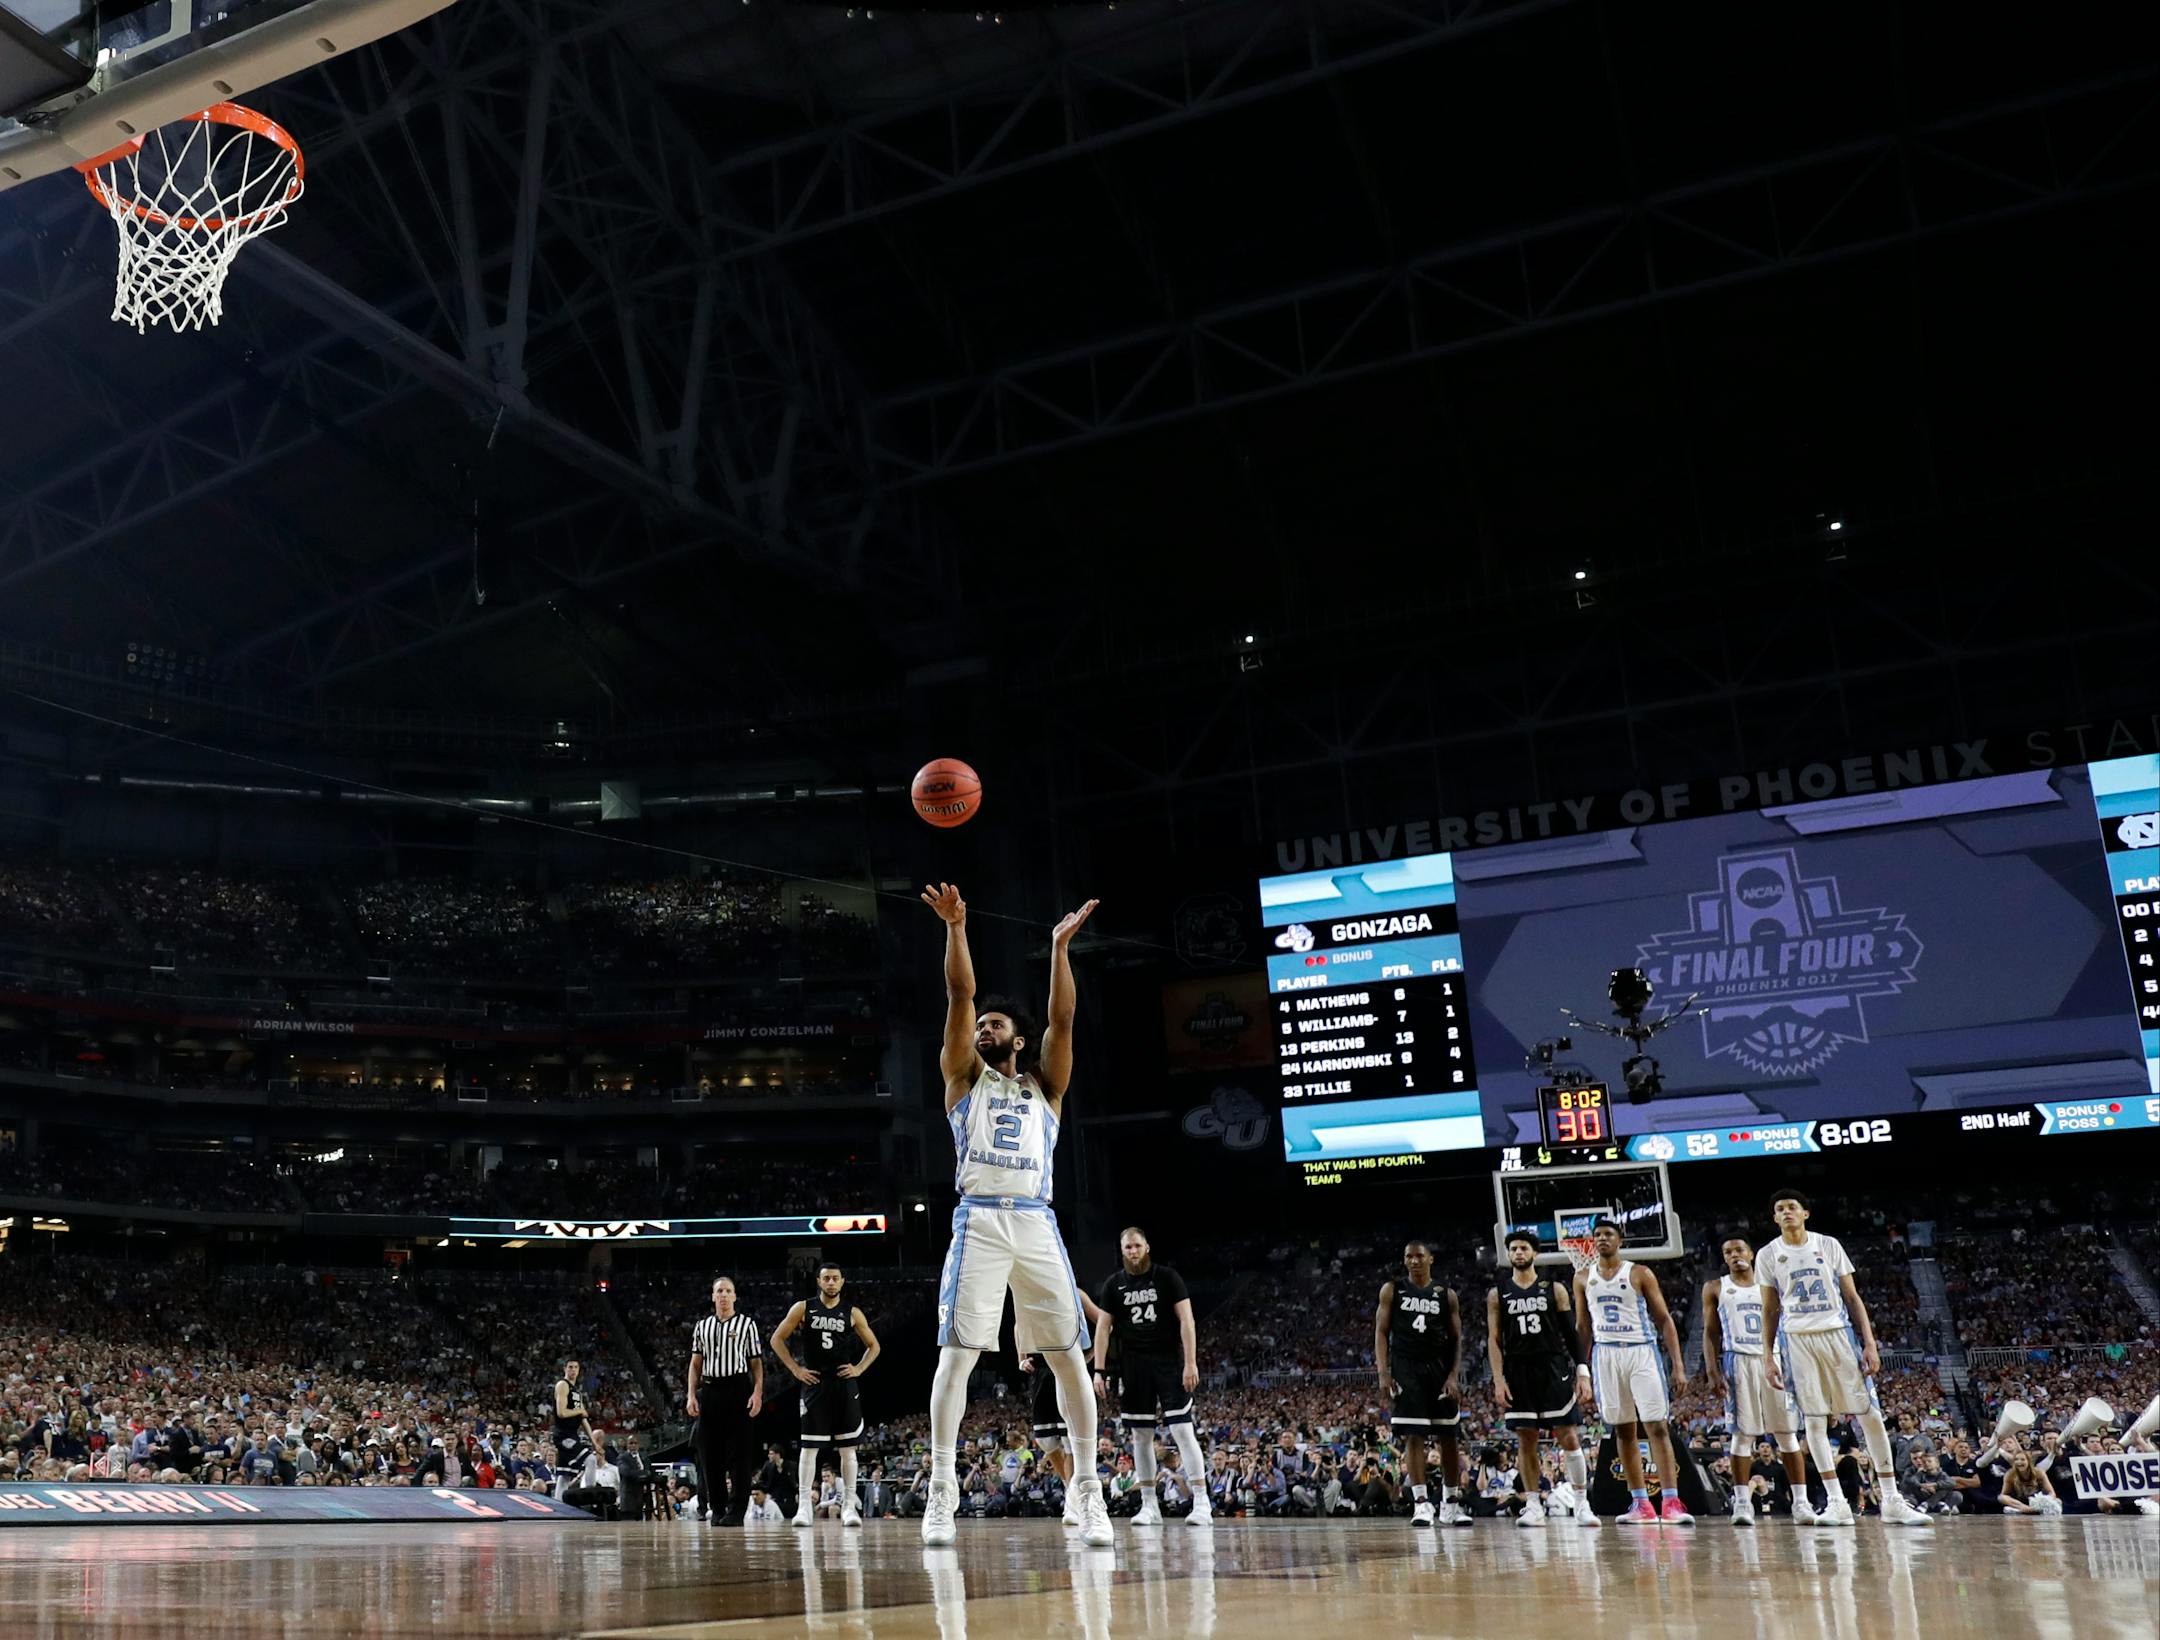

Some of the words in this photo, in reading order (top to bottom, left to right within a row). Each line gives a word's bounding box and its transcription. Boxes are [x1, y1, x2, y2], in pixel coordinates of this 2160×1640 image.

[1276, 796, 1596, 873] UNIVERSITY
[1619, 784, 1690, 825] OF
[1718, 739, 1993, 811] PHOENIX
[2026, 714, 2160, 767] STA
[1743, 884, 1785, 900] NCAA
[2124, 877, 2160, 893] PLA
[2122, 903, 2149, 918] 00
[1331, 913, 1433, 942] GONZAGA
[2134, 929, 2148, 942] 2
[1332, 950, 1373, 965] BONUS
[1671, 944, 1771, 987] FINAL
[1779, 934, 1875, 974] FOUR
[2139, 954, 2153, 966] 4
[1277, 975, 1328, 991] PLAYER
[1382, 964, 1413, 978] PTS.
[1431, 958, 1461, 973] FLS.
[1715, 978, 1790, 995] PHOENIX
[1796, 974, 1838, 987] 2017
[2144, 980, 2158, 993] 5
[1280, 1001, 1290, 1013] 4
[1296, 992, 1370, 1012] MATHEWS
[1443, 983, 1452, 995] 1
[254, 1020, 302, 1031] ADRIAN
[304, 1021, 354, 1033] WILSON
[1282, 1023, 1292, 1034] 5
[1298, 1014, 1379, 1033] WILLIAMS-
[1397, 1010, 1407, 1022] 7
[1446, 1005, 1455, 1017] 1
[703, 1027, 746, 1039] JIMMY
[750, 1025, 834, 1037] CONZELMAN
[1280, 1044, 1298, 1056] 13
[1301, 1036, 1365, 1055] PERKINS
[1396, 1032, 1414, 1045] 13
[1447, 1027, 1458, 1039] 2
[1281, 1062, 1301, 1075] 24
[1302, 1053, 1392, 1074] KARNOWSKI
[1401, 1051, 1412, 1064] 9
[1450, 1046, 1461, 1059] 4
[1283, 1085, 1303, 1098] 33
[1305, 1081, 1352, 1096] TILLIE
[1405, 1075, 1414, 1087] 1
[1453, 1070, 1463, 1083] 2
[1559, 1089, 1602, 1109] 8:02
[1961, 1113, 1995, 1131] 2ND
[1997, 1110, 2031, 1128] Half
[2056, 1104, 2108, 1118] BONUS
[993, 1114, 1022, 1151] 2
[1557, 1109, 1601, 1142] 30
[1753, 1127, 1799, 1141] BONUS
[1820, 1119, 1893, 1146] 8:02
[2059, 1118, 2099, 1131] POSS
[1502, 1147, 1521, 1160] TM
[1686, 1133, 1719, 1156] 52
[1765, 1139, 1801, 1152] POSS
[968, 1149, 1039, 1172] CAROLINA
[1303, 1161, 1331, 1173] THAT
[1332, 1159, 1357, 1171] WAS
[1358, 1158, 1376, 1169] HIS
[1378, 1154, 1426, 1168] FOURTH.
[1304, 1174, 1342, 1186] TEAM'S
[1123, 1288, 1158, 1306] ZAGS
[1792, 1279, 1828, 1303] 44
[1131, 1304, 1157, 1325] 24
[1400, 1297, 1440, 1315] ZAGS
[1507, 1296, 1548, 1315] ZAGS
[1603, 1305, 1620, 1323] 5
[810, 1315, 845, 1332] ZAGS
[1412, 1314, 1427, 1333] 4
[1516, 1313, 1542, 1335] 13
[1744, 1313, 1761, 1334] 0
[821, 1332, 833, 1349] 5
[2078, 1458, 2160, 1493] NOISE
[44, 1489, 213, 1514] BERRY
[203, 1491, 262, 1513] II
[432, 1489, 504, 1517] 2
